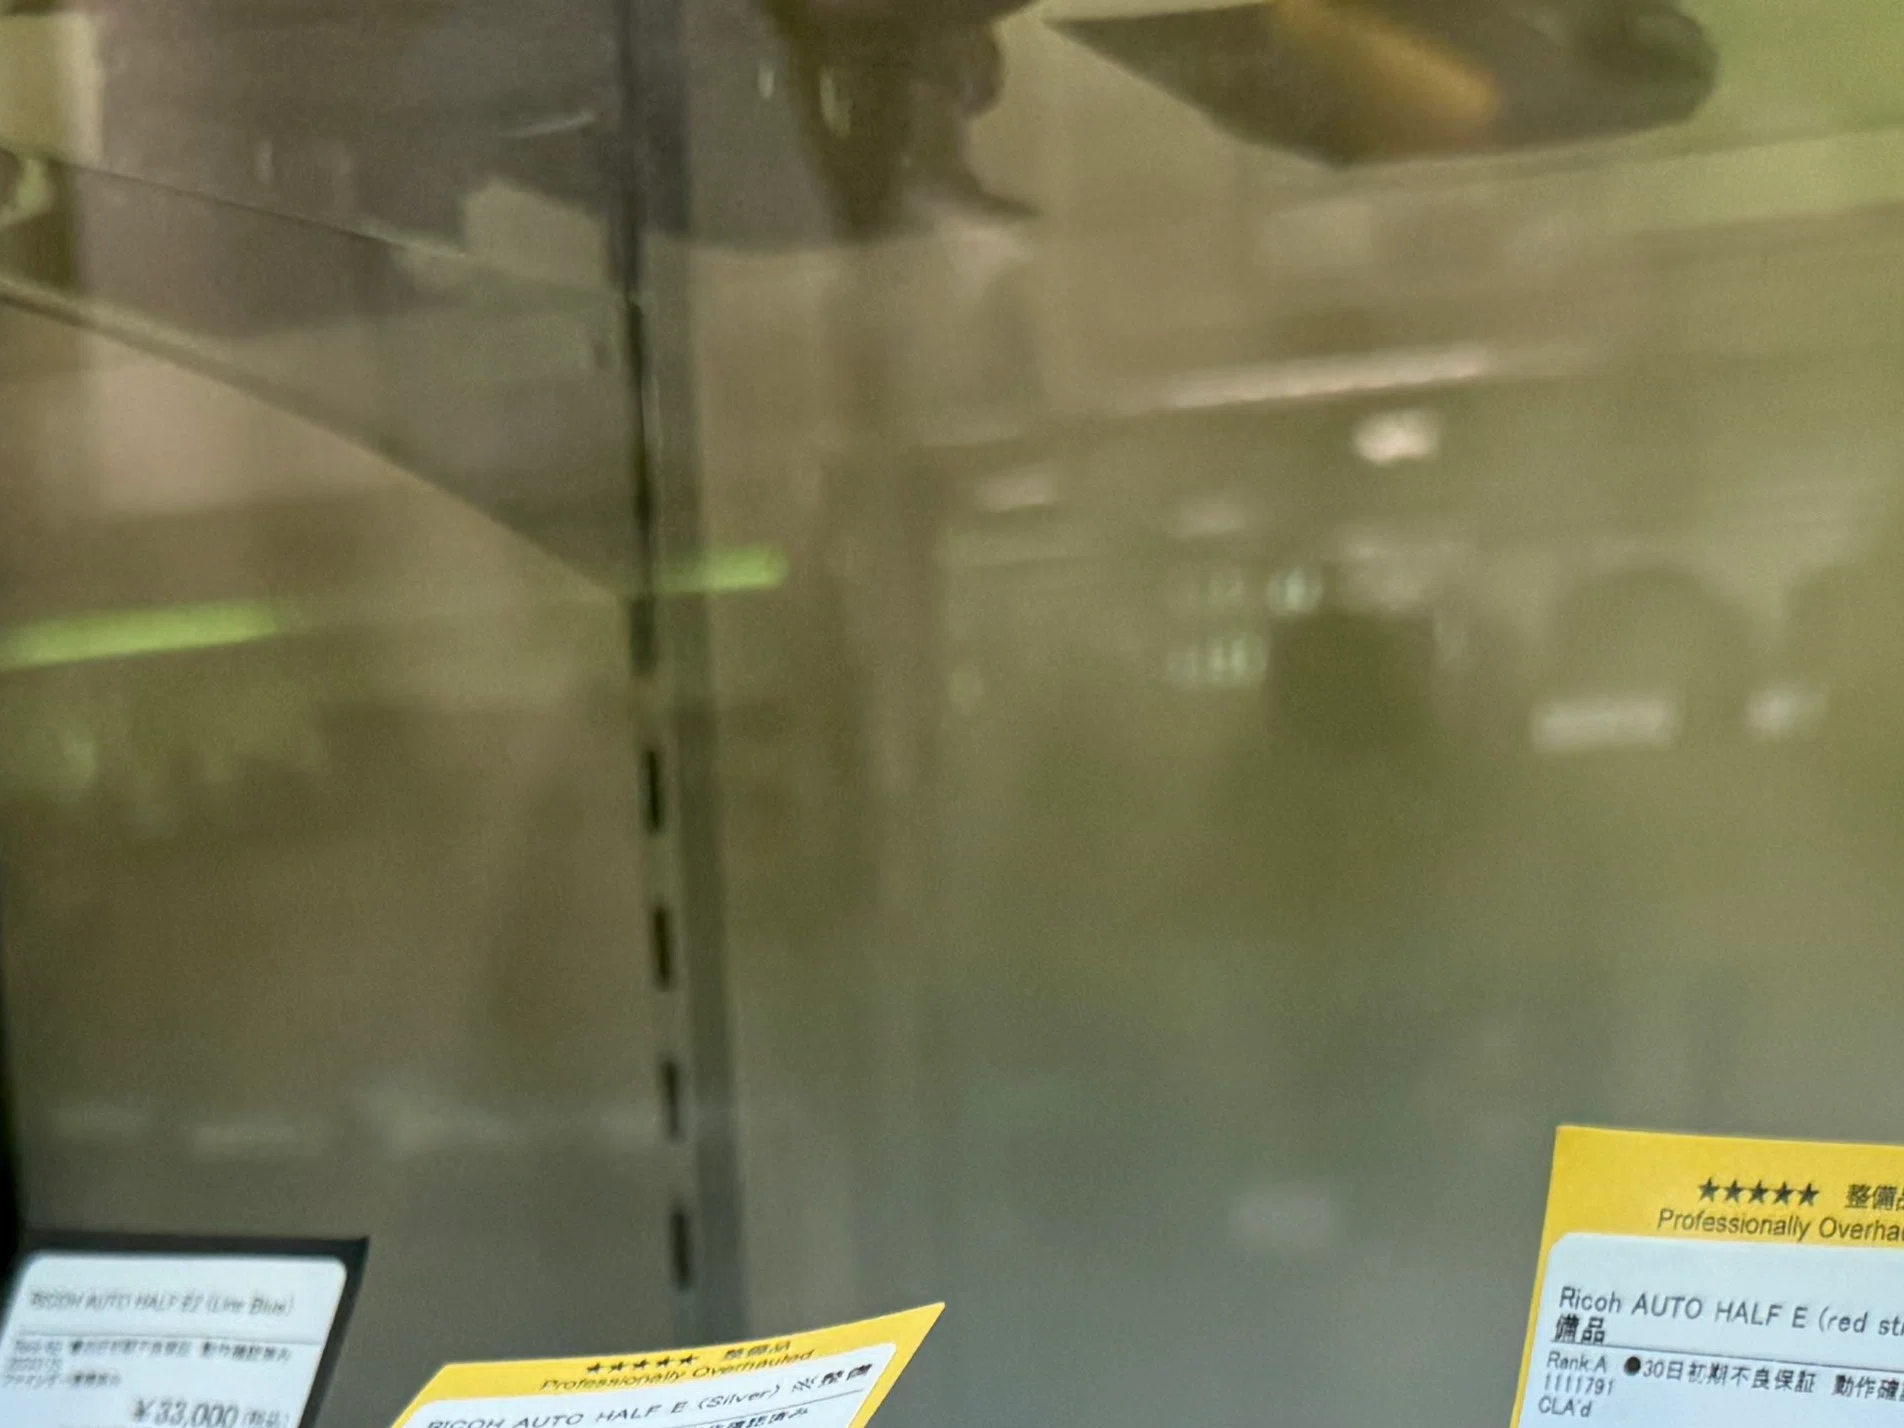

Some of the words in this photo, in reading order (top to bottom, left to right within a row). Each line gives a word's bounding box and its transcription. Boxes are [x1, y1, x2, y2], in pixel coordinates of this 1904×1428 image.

[1657, 1208, 1810, 1241] Professionally
[1559, 1286, 1622, 1314] Ricoh
[1632, 1295, 1702, 1321] AUTO
[1715, 1301, 1780, 1328] HALF
[1793, 1306, 1808, 1330] E
[1818, 1307, 1868, 1336] (red
[1554, 1315, 1606, 1344] 備品
[540, 1370, 686, 1391] Professionally
[692, 1350, 814, 1378] Overhauled
[596, 1405, 663, 1421] HALF
[670, 1401, 688, 1414] E
[698, 1385, 780, 1411] (Silver)
